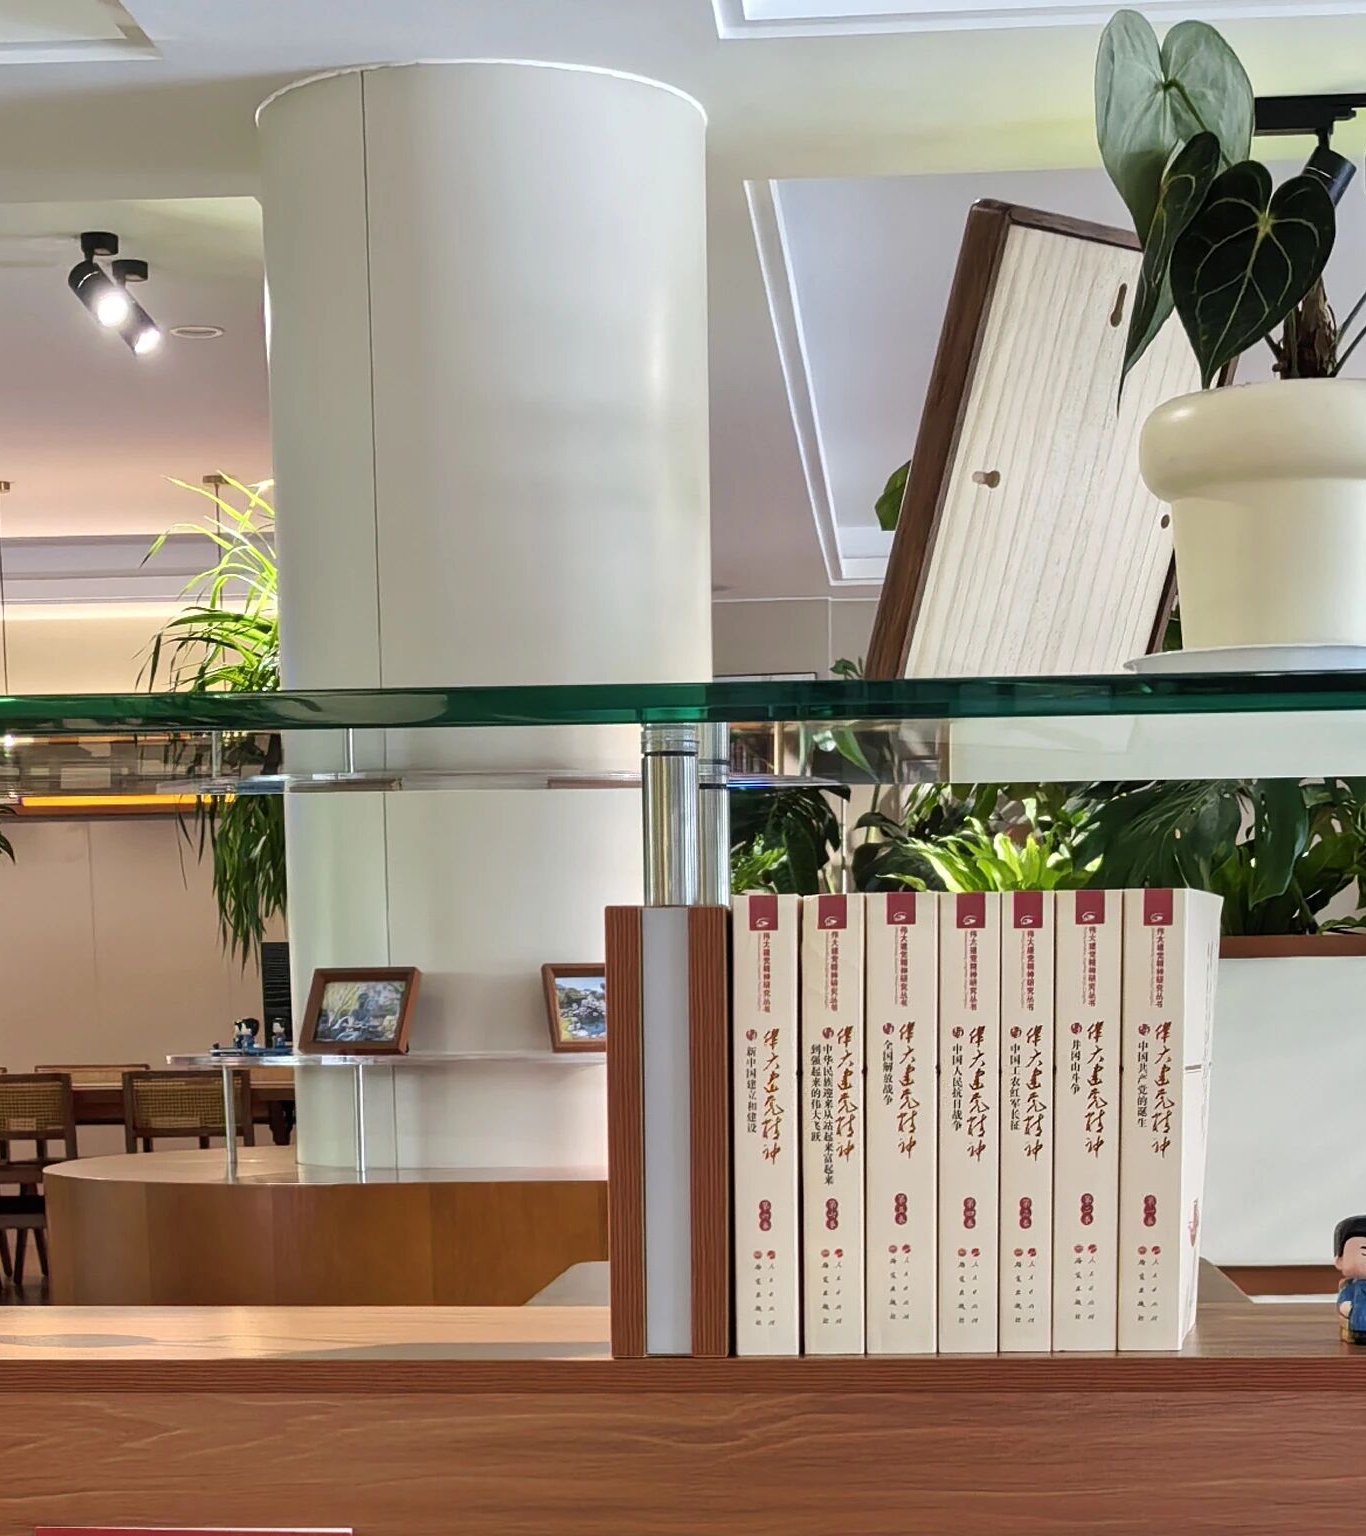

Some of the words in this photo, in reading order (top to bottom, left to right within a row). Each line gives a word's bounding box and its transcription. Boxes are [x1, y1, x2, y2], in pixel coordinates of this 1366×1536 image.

[952, 1043, 963, 1131] 中国人民抗日战争
[1009, 1043, 1021, 1131] 中国工农红军长征
[1137, 1041, 1148, 1128] 中国共产党的诞生
